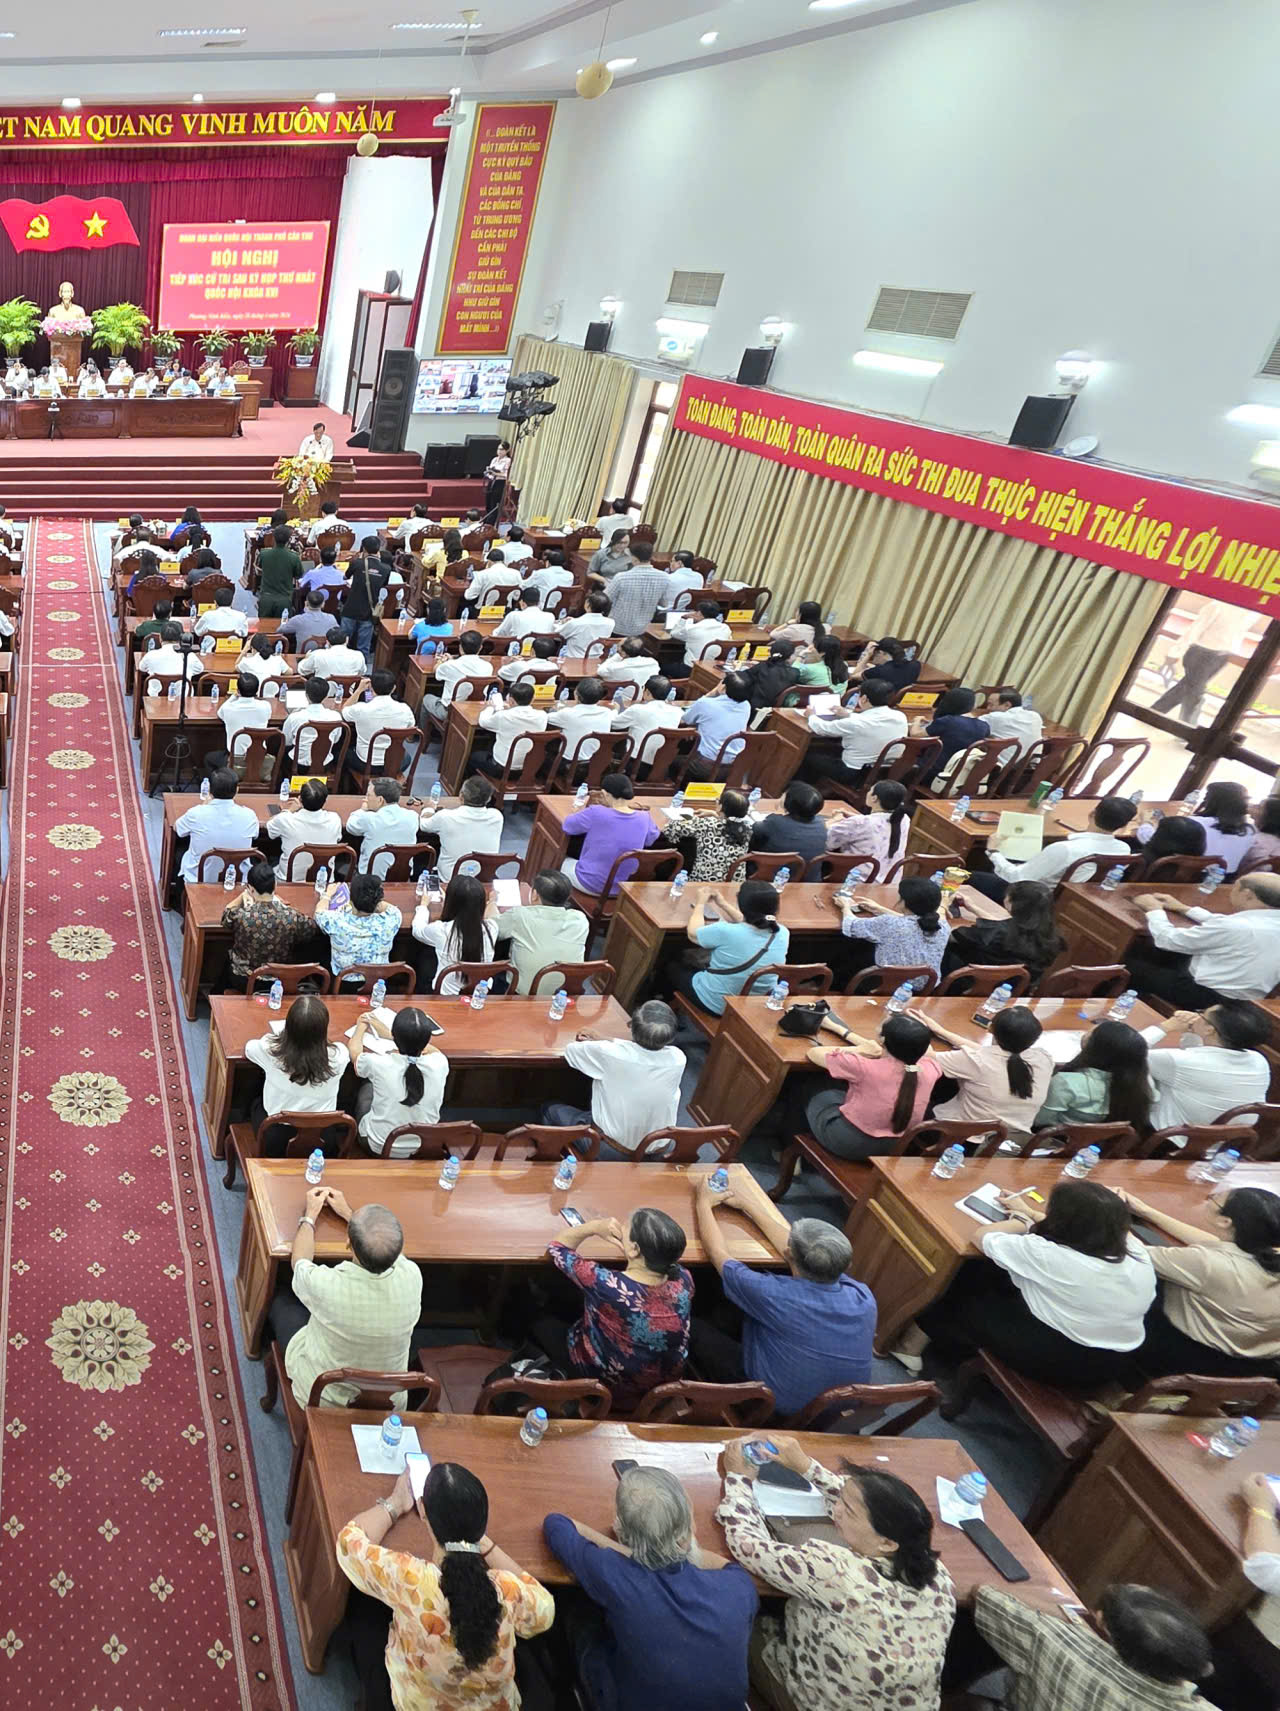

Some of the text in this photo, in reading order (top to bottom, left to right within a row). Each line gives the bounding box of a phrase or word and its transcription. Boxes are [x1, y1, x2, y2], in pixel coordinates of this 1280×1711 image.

[24, 116, 81, 139] NAM
[86, 114, 173, 141] QUANG
[181, 112, 247, 135] VINH
[252, 106, 330, 134] MUÔN
[336, 105, 396, 132] NĂM
[211, 248, 279, 268] HỘI NGHỊ
[686, 394, 710, 425] TOÀN
[709, 397, 737, 438] ĐẢNG,
[739, 409, 768, 442] TOÀN
[766, 416, 792, 456] DÂN,
[793, 424, 828, 460] TOÀN
[826, 434, 867, 471] QUÂN
[861, 446, 887, 478] RA
[884, 446, 919, 487] SỨC
[916, 458, 948, 494] THI
[942, 467, 982, 506] ĐUA
[982, 478, 1036, 525] THỰC
[1032, 488, 1091, 541] HIỆN
[1087, 498, 1172, 560] THẮNG
[1166, 526, 1222, 579] LỢI
